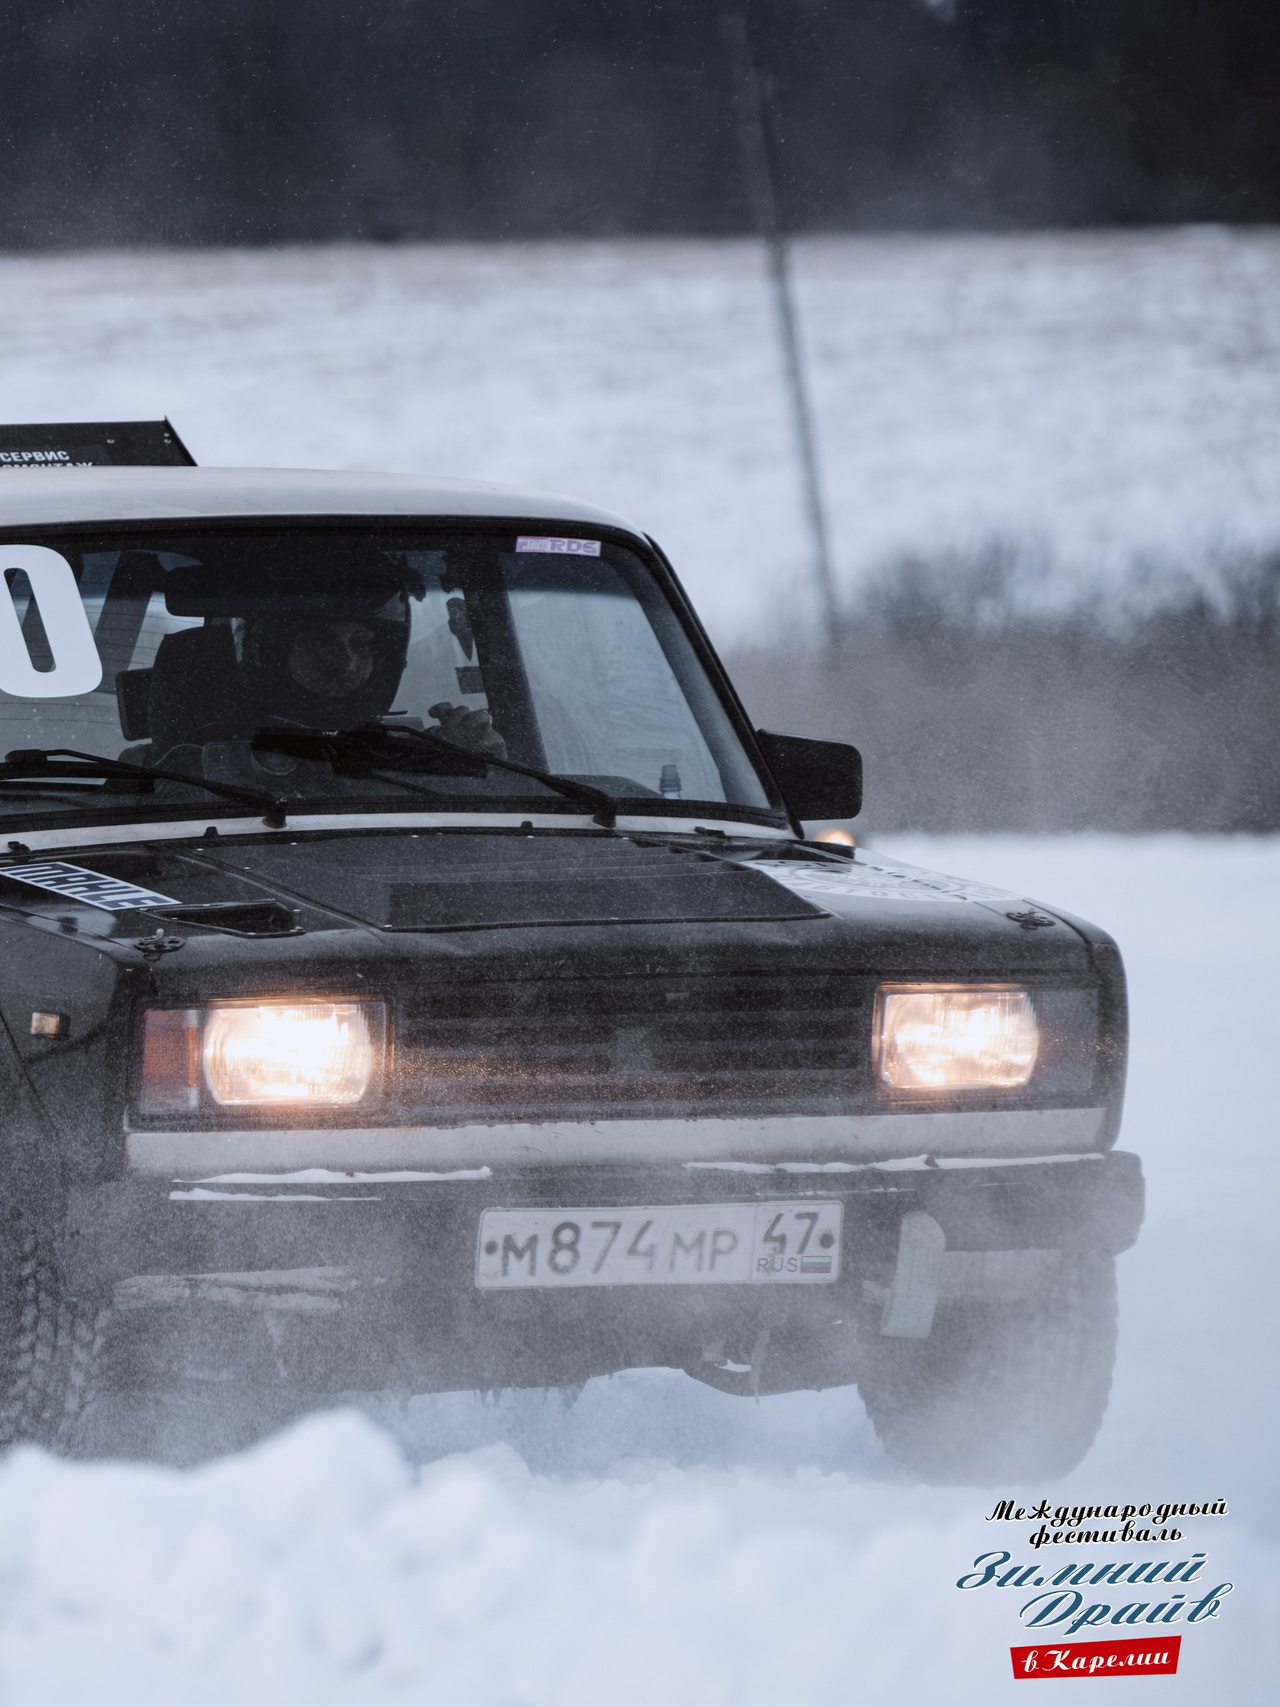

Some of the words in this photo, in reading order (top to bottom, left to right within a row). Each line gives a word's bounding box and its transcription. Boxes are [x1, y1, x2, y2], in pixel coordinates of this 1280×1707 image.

[549, 539, 598, 554] RDS
[762, 1212, 819, 1255] 47
[757, 1256, 799, 1274] RUS
